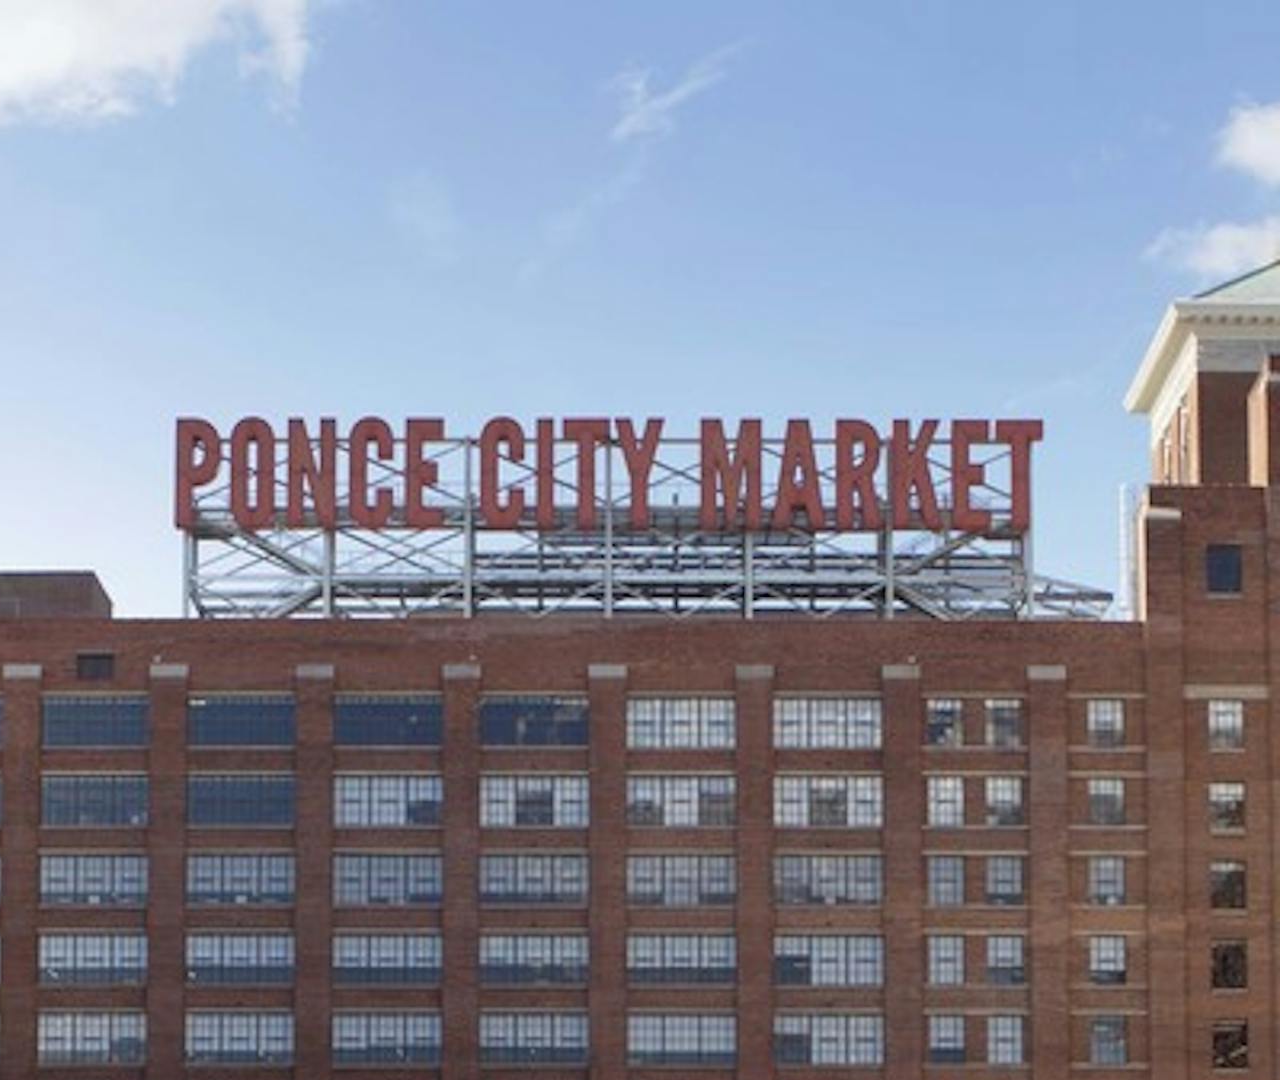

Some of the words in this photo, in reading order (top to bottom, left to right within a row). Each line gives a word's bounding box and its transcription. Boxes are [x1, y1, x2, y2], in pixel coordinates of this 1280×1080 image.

[175, 416, 445, 530] PONCE
[480, 416, 664, 530] CITY
[700, 417, 1044, 531] MARKET
